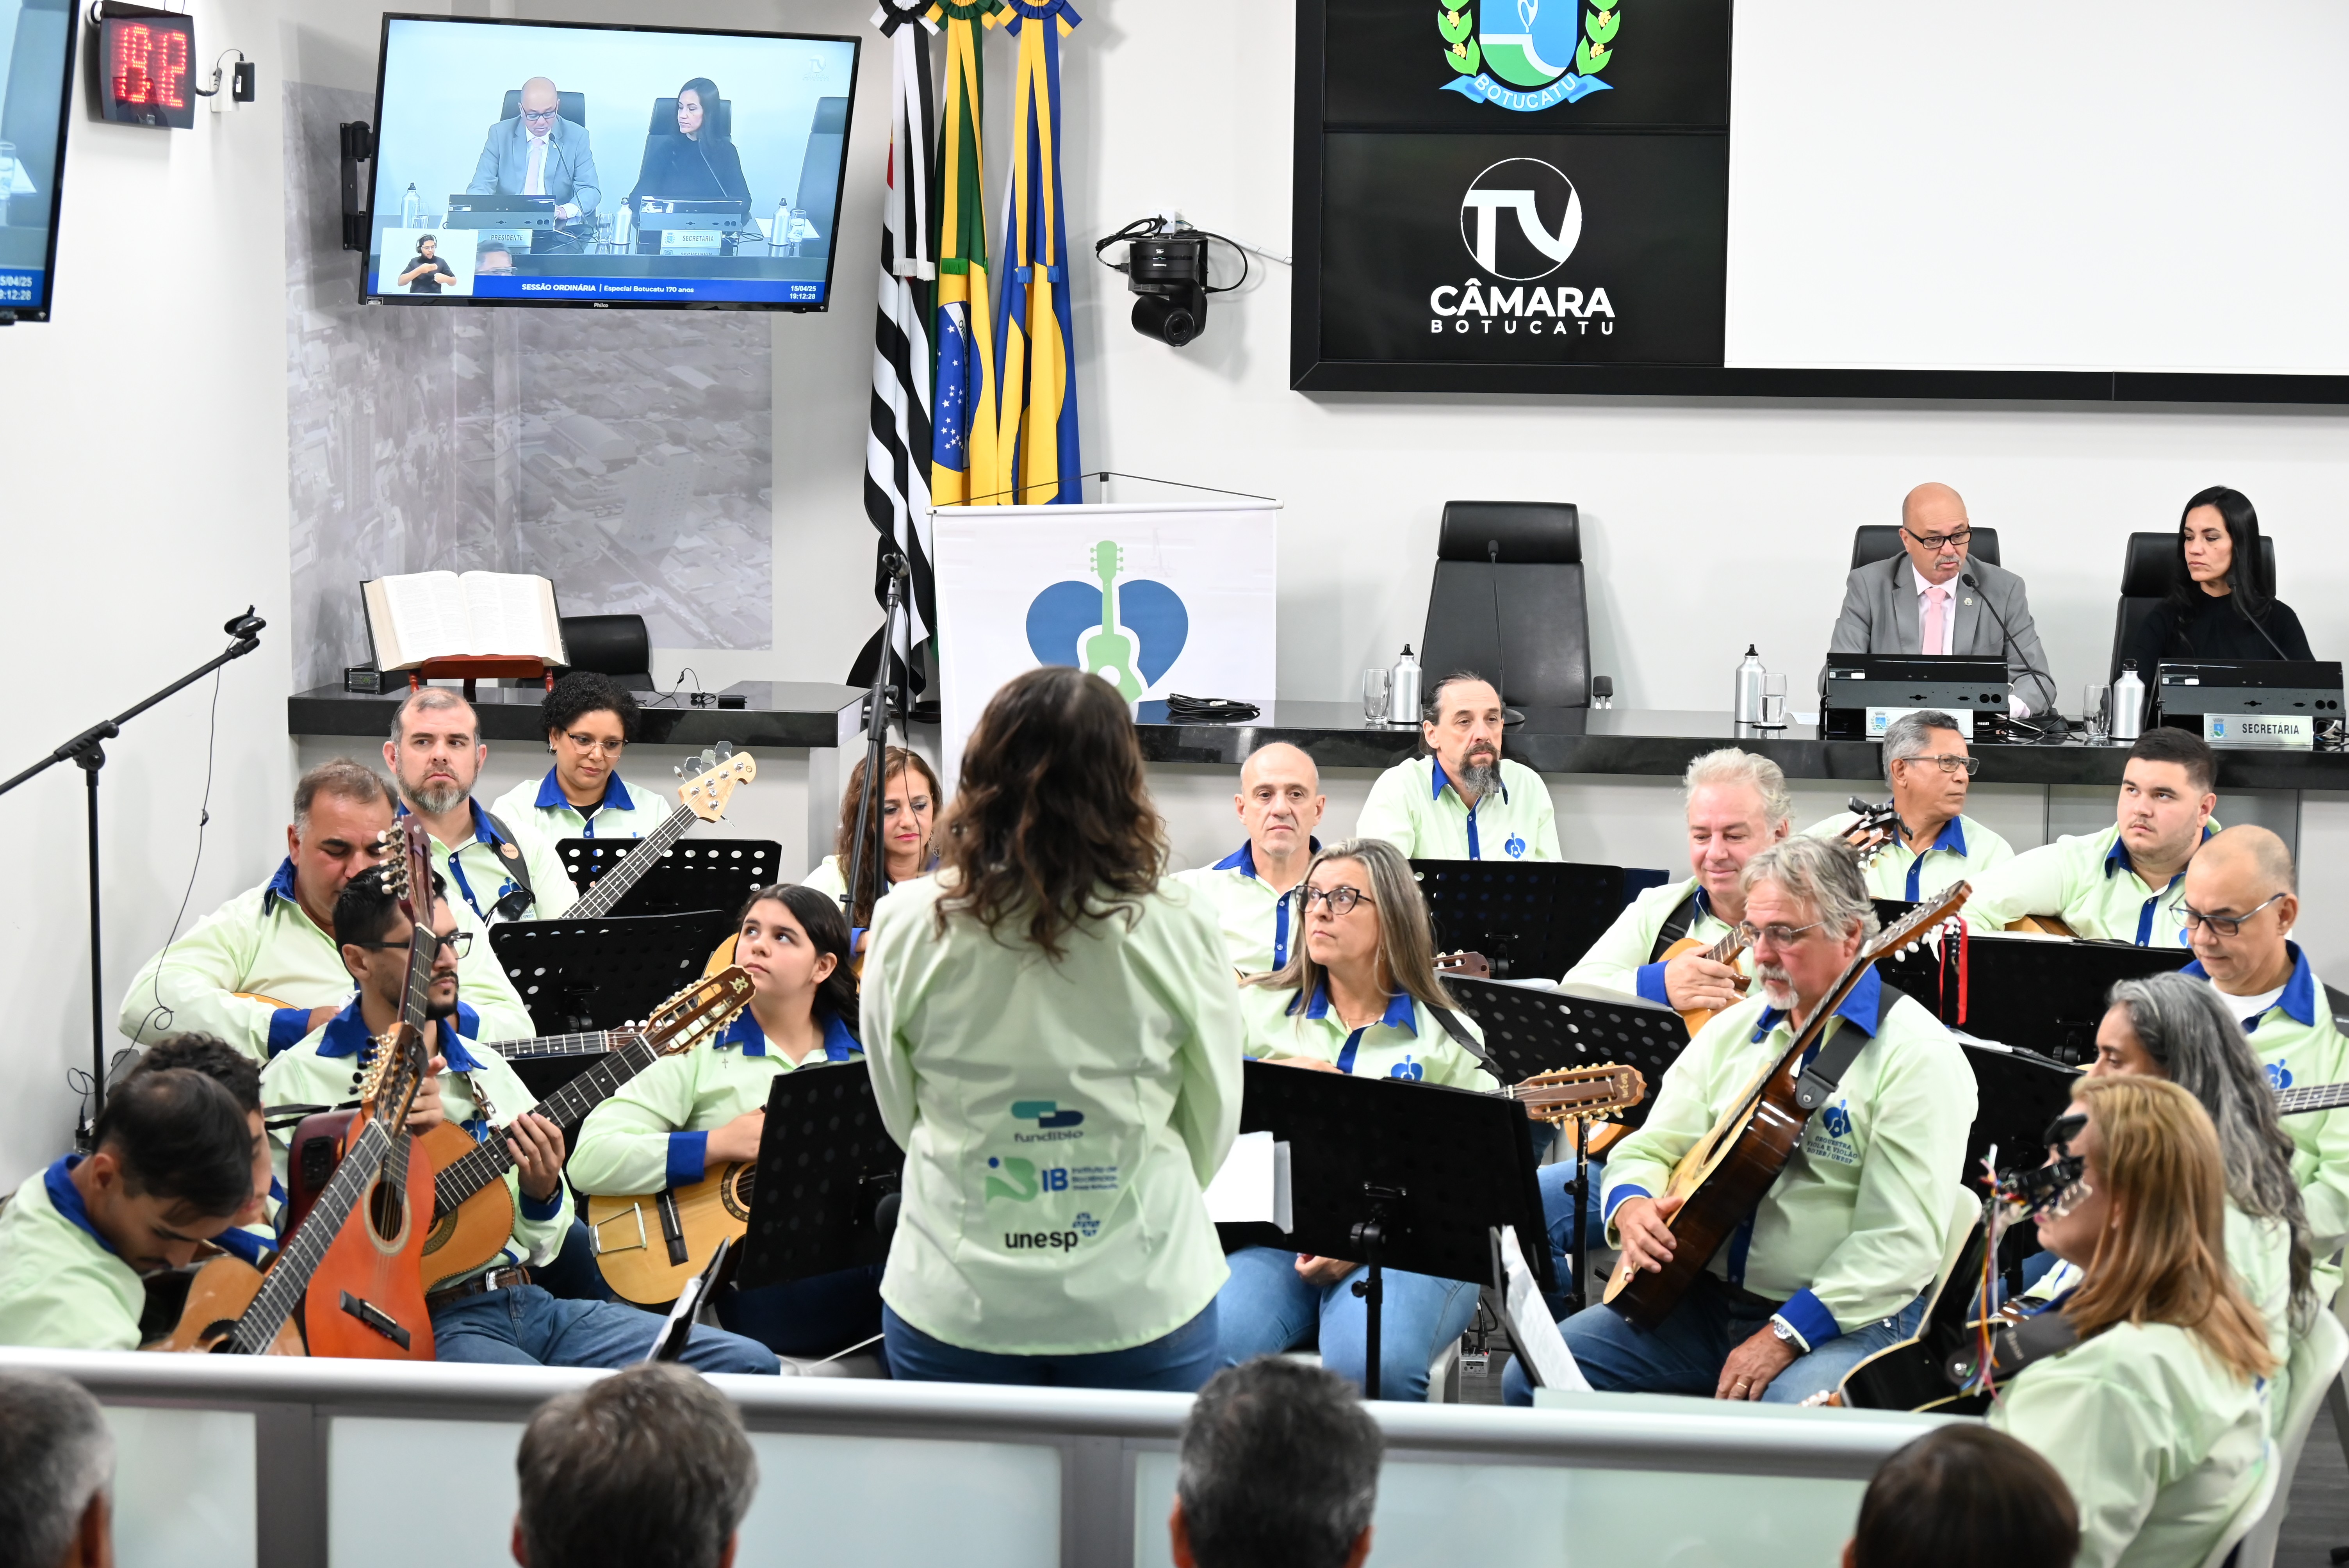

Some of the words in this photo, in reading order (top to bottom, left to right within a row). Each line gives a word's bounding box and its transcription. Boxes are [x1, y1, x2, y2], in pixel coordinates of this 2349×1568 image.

[1474, 74, 1577, 109] BOTUCATU
[1463, 188, 1582, 273] TV
[0, 275, 32, 287] 5/04/25
[0, 289, 32, 300] 9:12:28
[1430, 278, 1615, 318] CÂMARA
[1431, 320, 1613, 335] BOTUCATU
[2242, 722, 2299, 734] SECRETÁRIA
[1014, 1130, 1084, 1143] fundibio
[1815, 1136, 1851, 1149] ORQUESTRA
[1807, 1141, 1825, 1149] VIOLA
[1042, 1168, 1068, 1192] IB
[1005, 1231, 1078, 1253] unesp
